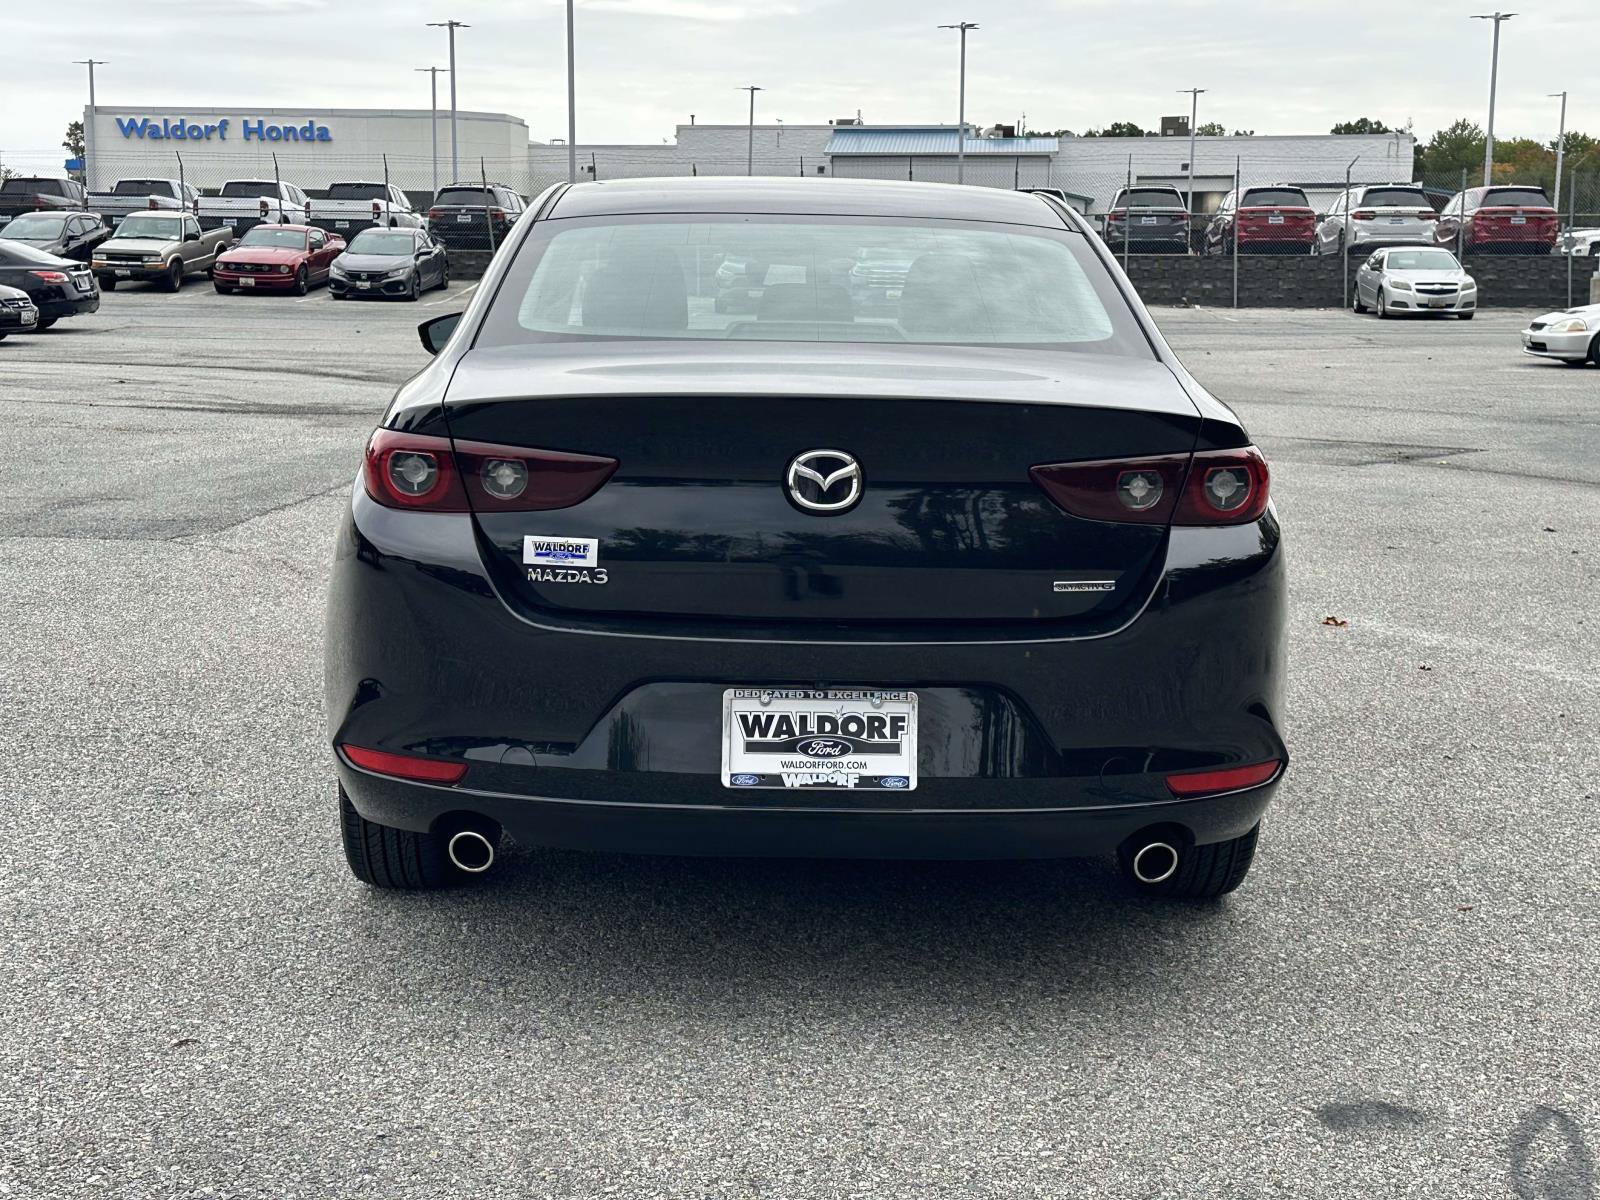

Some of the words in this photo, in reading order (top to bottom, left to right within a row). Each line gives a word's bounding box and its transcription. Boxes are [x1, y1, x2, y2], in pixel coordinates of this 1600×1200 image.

[115, 117, 230, 140] Waldorf
[242, 119, 333, 142] Honda
[533, 542, 589, 554] WALDORF
[735, 690, 804, 699] DEDICATED
[807, 691, 824, 699] TO
[827, 691, 907, 700] EXCELLENCE
[737, 712, 907, 740] WALDORF
[808, 741, 842, 756] Ford
[780, 760, 868, 770] WALDORFFORD.COM
[780, 771, 860, 788] WALDORF
